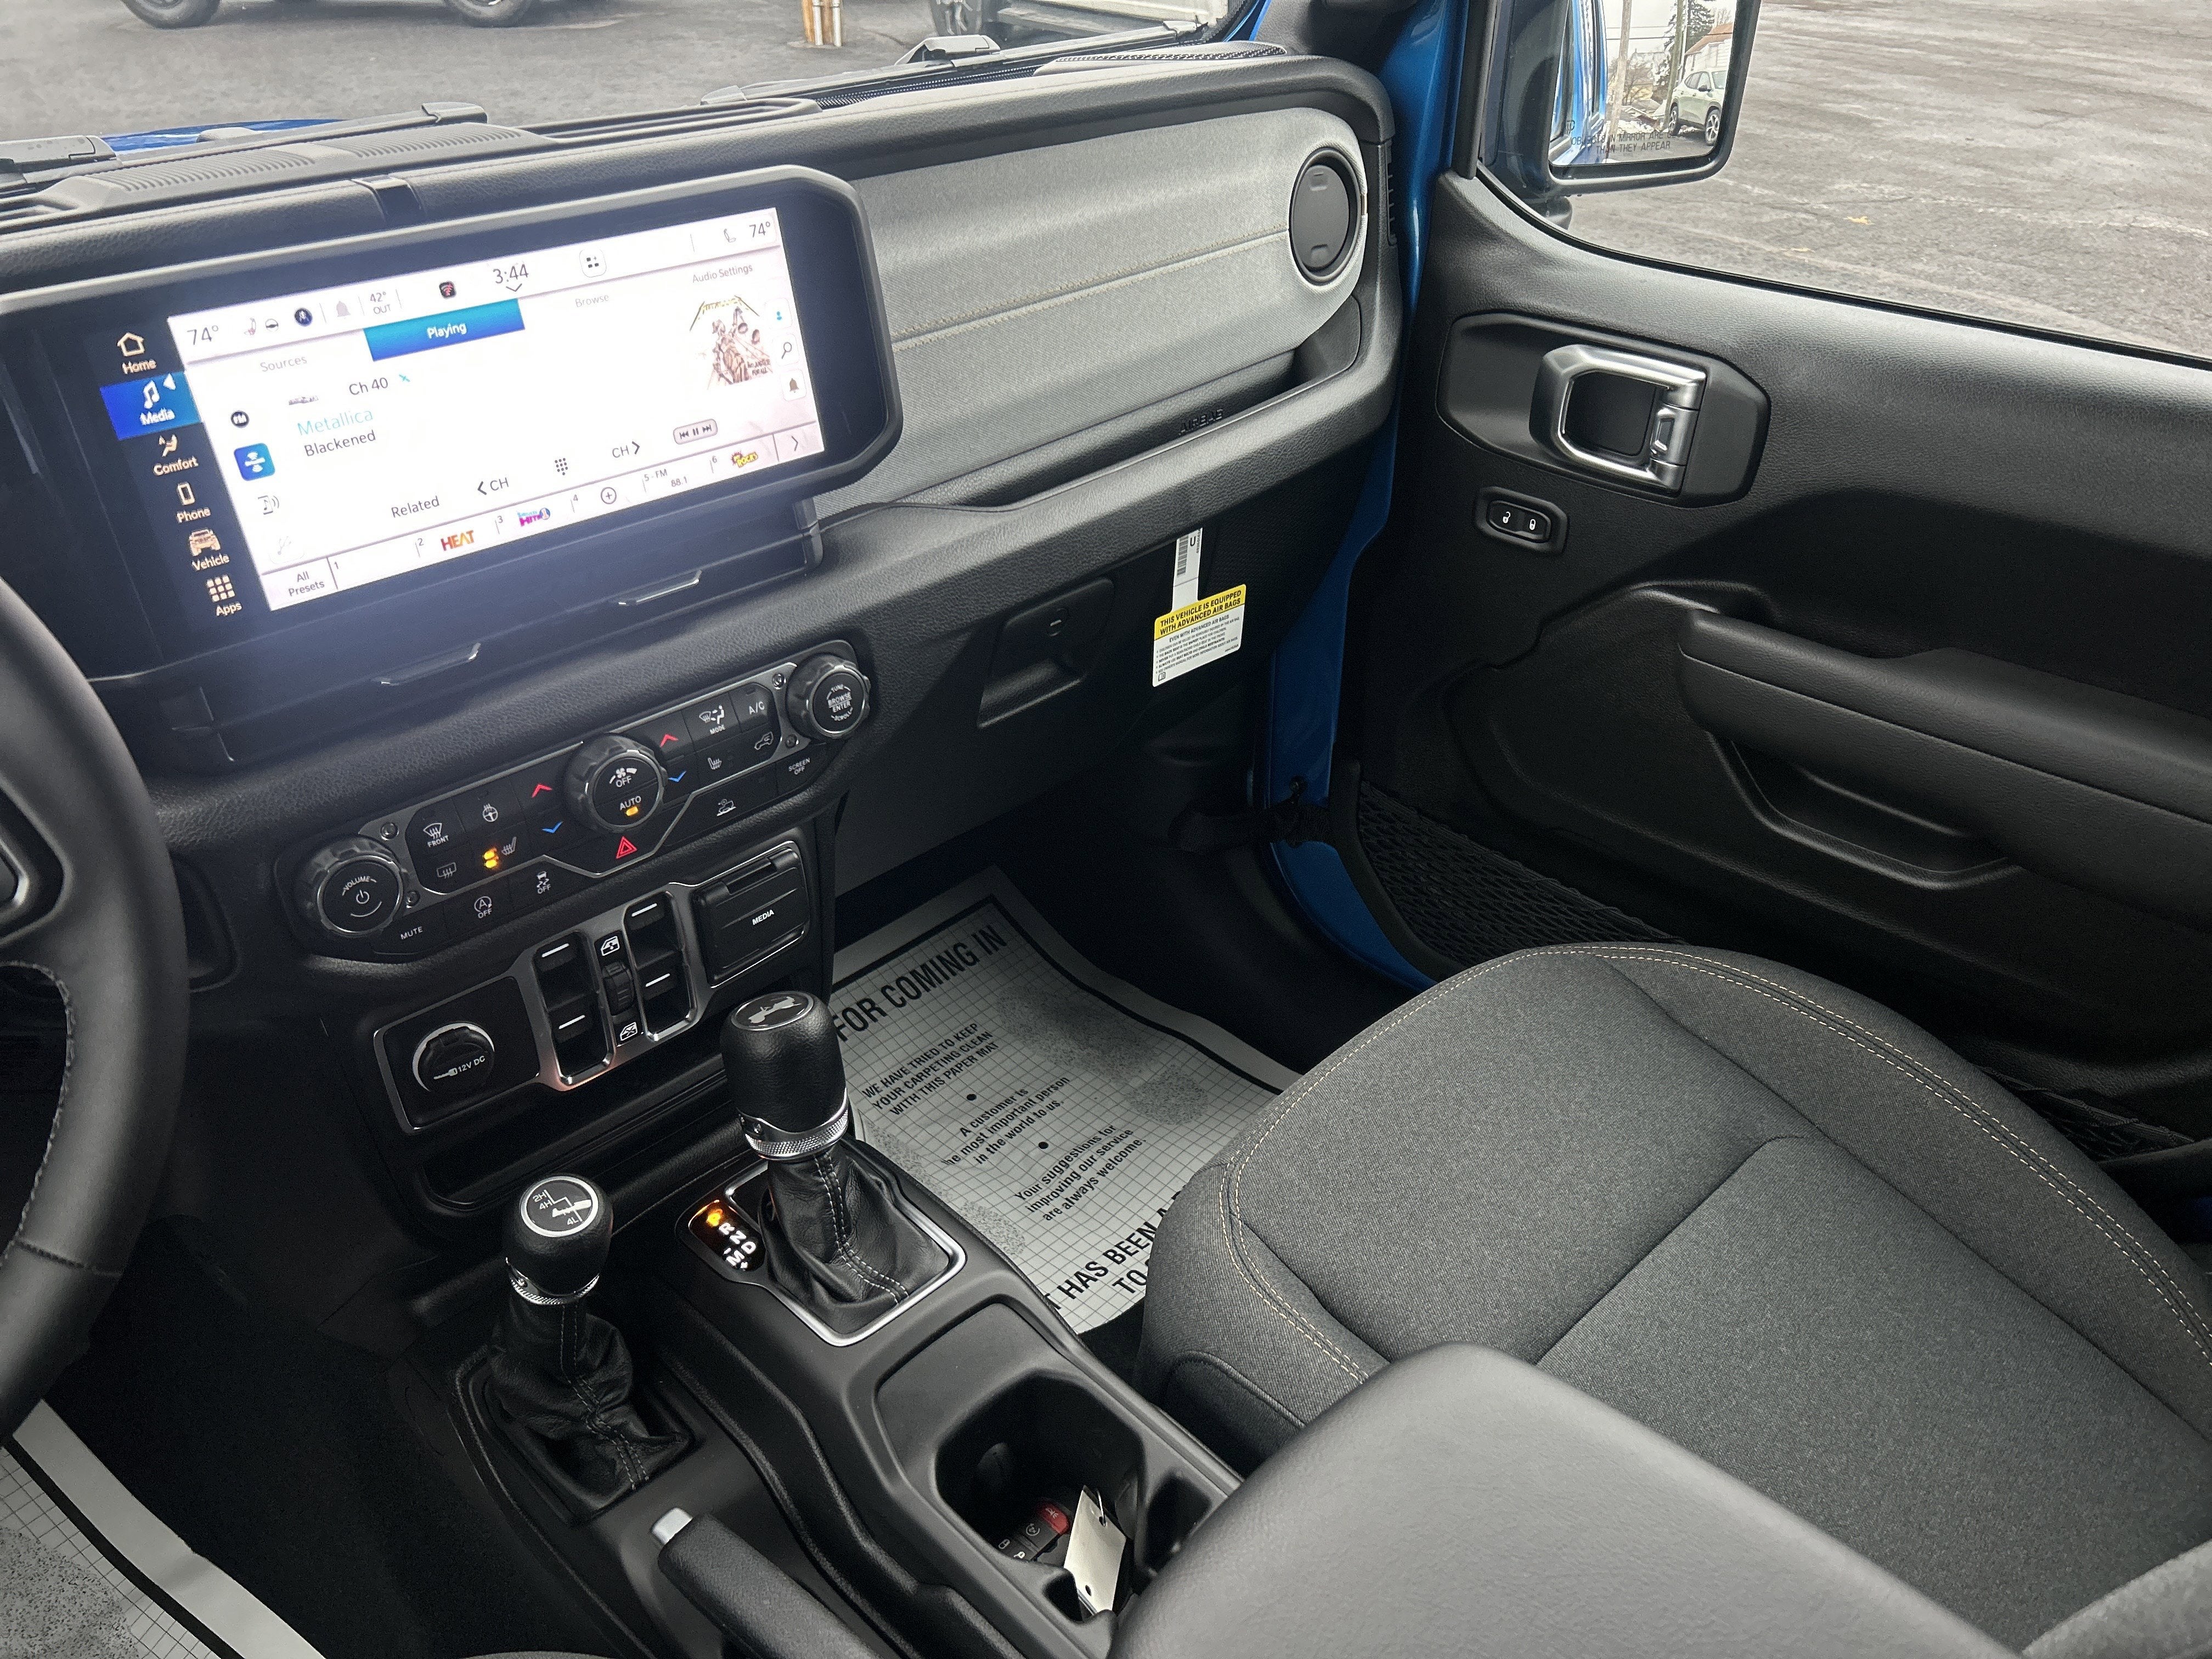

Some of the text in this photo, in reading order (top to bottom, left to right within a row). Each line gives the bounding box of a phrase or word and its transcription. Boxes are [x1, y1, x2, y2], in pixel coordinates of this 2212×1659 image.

[1619, 133, 1645, 142] MIRROR
[1620, 144, 1637, 153] THEY
[1640, 141, 1671, 151] APPEAR
[493, 264, 529, 284] 3:44
[692, 264, 753, 283] Audio Settings
[373, 304, 391, 314] OUT
[575, 294, 609, 308] Browse
[427, 321, 467, 339] Playing
[121, 358, 156, 375] Home
[260, 356, 307, 373] Sources
[349, 377, 388, 396] Ch 40
[140, 408, 175, 425] Media
[297, 408, 374, 436] Metallica
[304, 430, 376, 457] Blackened
[612, 445, 629, 458] CH
[153, 456, 198, 476] Comfort
[655, 469, 668, 479] FM
[489, 477, 509, 491] CH
[671, 477, 687, 487] 88.1
[573, 494, 578, 502] 4
[177, 506, 211, 523] Phone
[391, 496, 440, 518] Related
[498, 515, 503, 523] 3
[419, 538, 424, 546] 2
[441, 530, 475, 551] HEAT
[191, 553, 230, 572] Vehicle
[335, 561, 339, 569] 1
[297, 571, 309, 582] All
[288, 579, 325, 596] Presets
[215, 601, 242, 617] Apps
[1160, 617, 1175, 627] THIS
[1176, 605, 1202, 620] VEHICLE
[1211, 590, 1242, 607] EQUIPPED
[1160, 598, 1240, 635] WITH ADVANCED AIR BAGS
[1191, 622, 1211, 633] ADVANCED
[748, 701, 765, 715] A/C
[828, 692, 852, 708] BROWSE
[832, 701, 850, 713] ENTER
[709, 724, 726, 735] MODE
[788, 757, 810, 773] SCREEN
[794, 766, 805, 776] OFF
[616, 775, 632, 788] OFF
[619, 795, 641, 811] AUTO
[427, 835, 449, 848] FRONT
[345, 876, 370, 890] VOLUME
[537, 884, 551, 894] OFF
[478, 908, 493, 918] OFF
[752, 910, 775, 926] MEDIA
[400, 927, 424, 940] MUTE
[832, 924, 1007, 1042] FOR COMING IN
[457, 1054, 486, 1074] 12V DC
[862, 1023, 979, 1098] WE HAVE TRIED TO KEEP
[873, 1031, 993, 1110] YOUR CARPETING CLEAN
[889, 1042, 1000, 1116] WITH THIS PAPER MAT
[960, 1088, 1029, 1137] A customer is
[961, 1132, 989, 1156] most
[988, 1099, 1038, 1135] important
[1035, 1076, 1070, 1103] person
[973, 1099, 1065, 1165] in the world to us.
[1014, 1124, 1118, 1201] Your suggestions for
[1025, 1127, 1134, 1214] improving our service
[1042, 1138, 1147, 1221] are always welcome.
[533, 1191, 546, 1203] 2H
[539, 1200, 551, 1210] 4H
[567, 1217, 579, 1226] 4L
[719, 1222, 735, 1235] R
[730, 1230, 747, 1245] N
[741, 1241, 757, 1254] D
[726, 1250, 745, 1267] M
[1057, 1260, 1108, 1299] HAS
[1103, 1221, 1157, 1265] BEEN
[1112, 1269, 1148, 1295] TO
